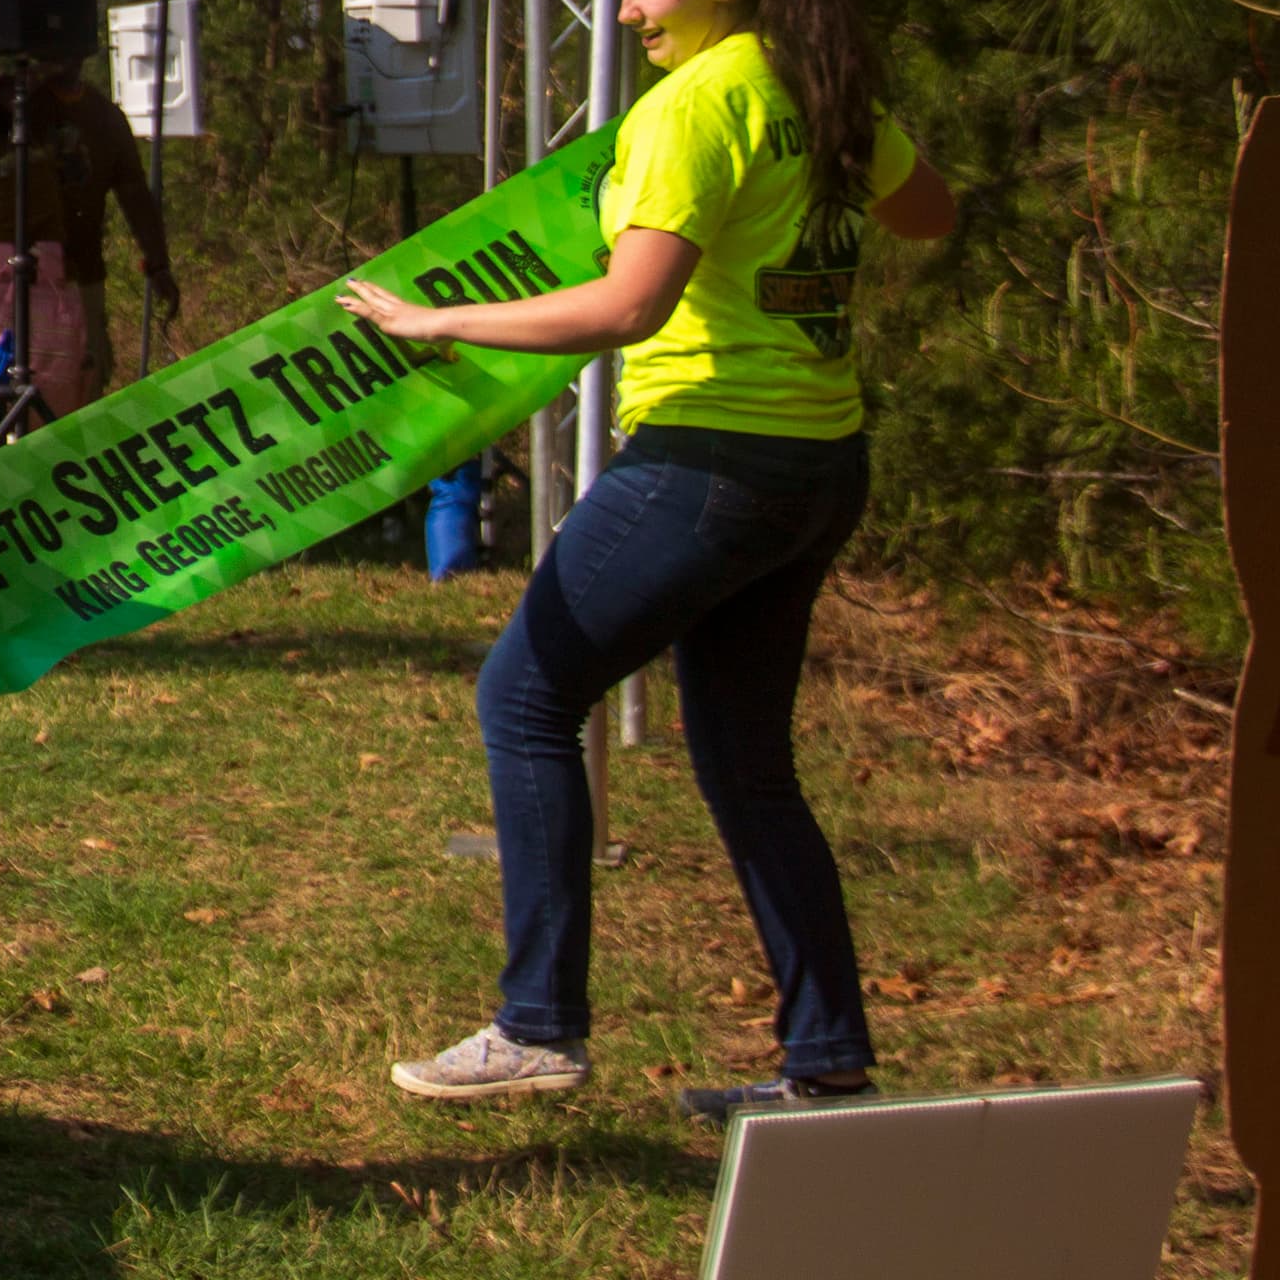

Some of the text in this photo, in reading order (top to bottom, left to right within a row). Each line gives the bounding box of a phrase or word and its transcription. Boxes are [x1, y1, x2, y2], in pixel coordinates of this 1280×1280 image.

[54, 429, 392, 622] KING GEORGE, VIRGINIA
